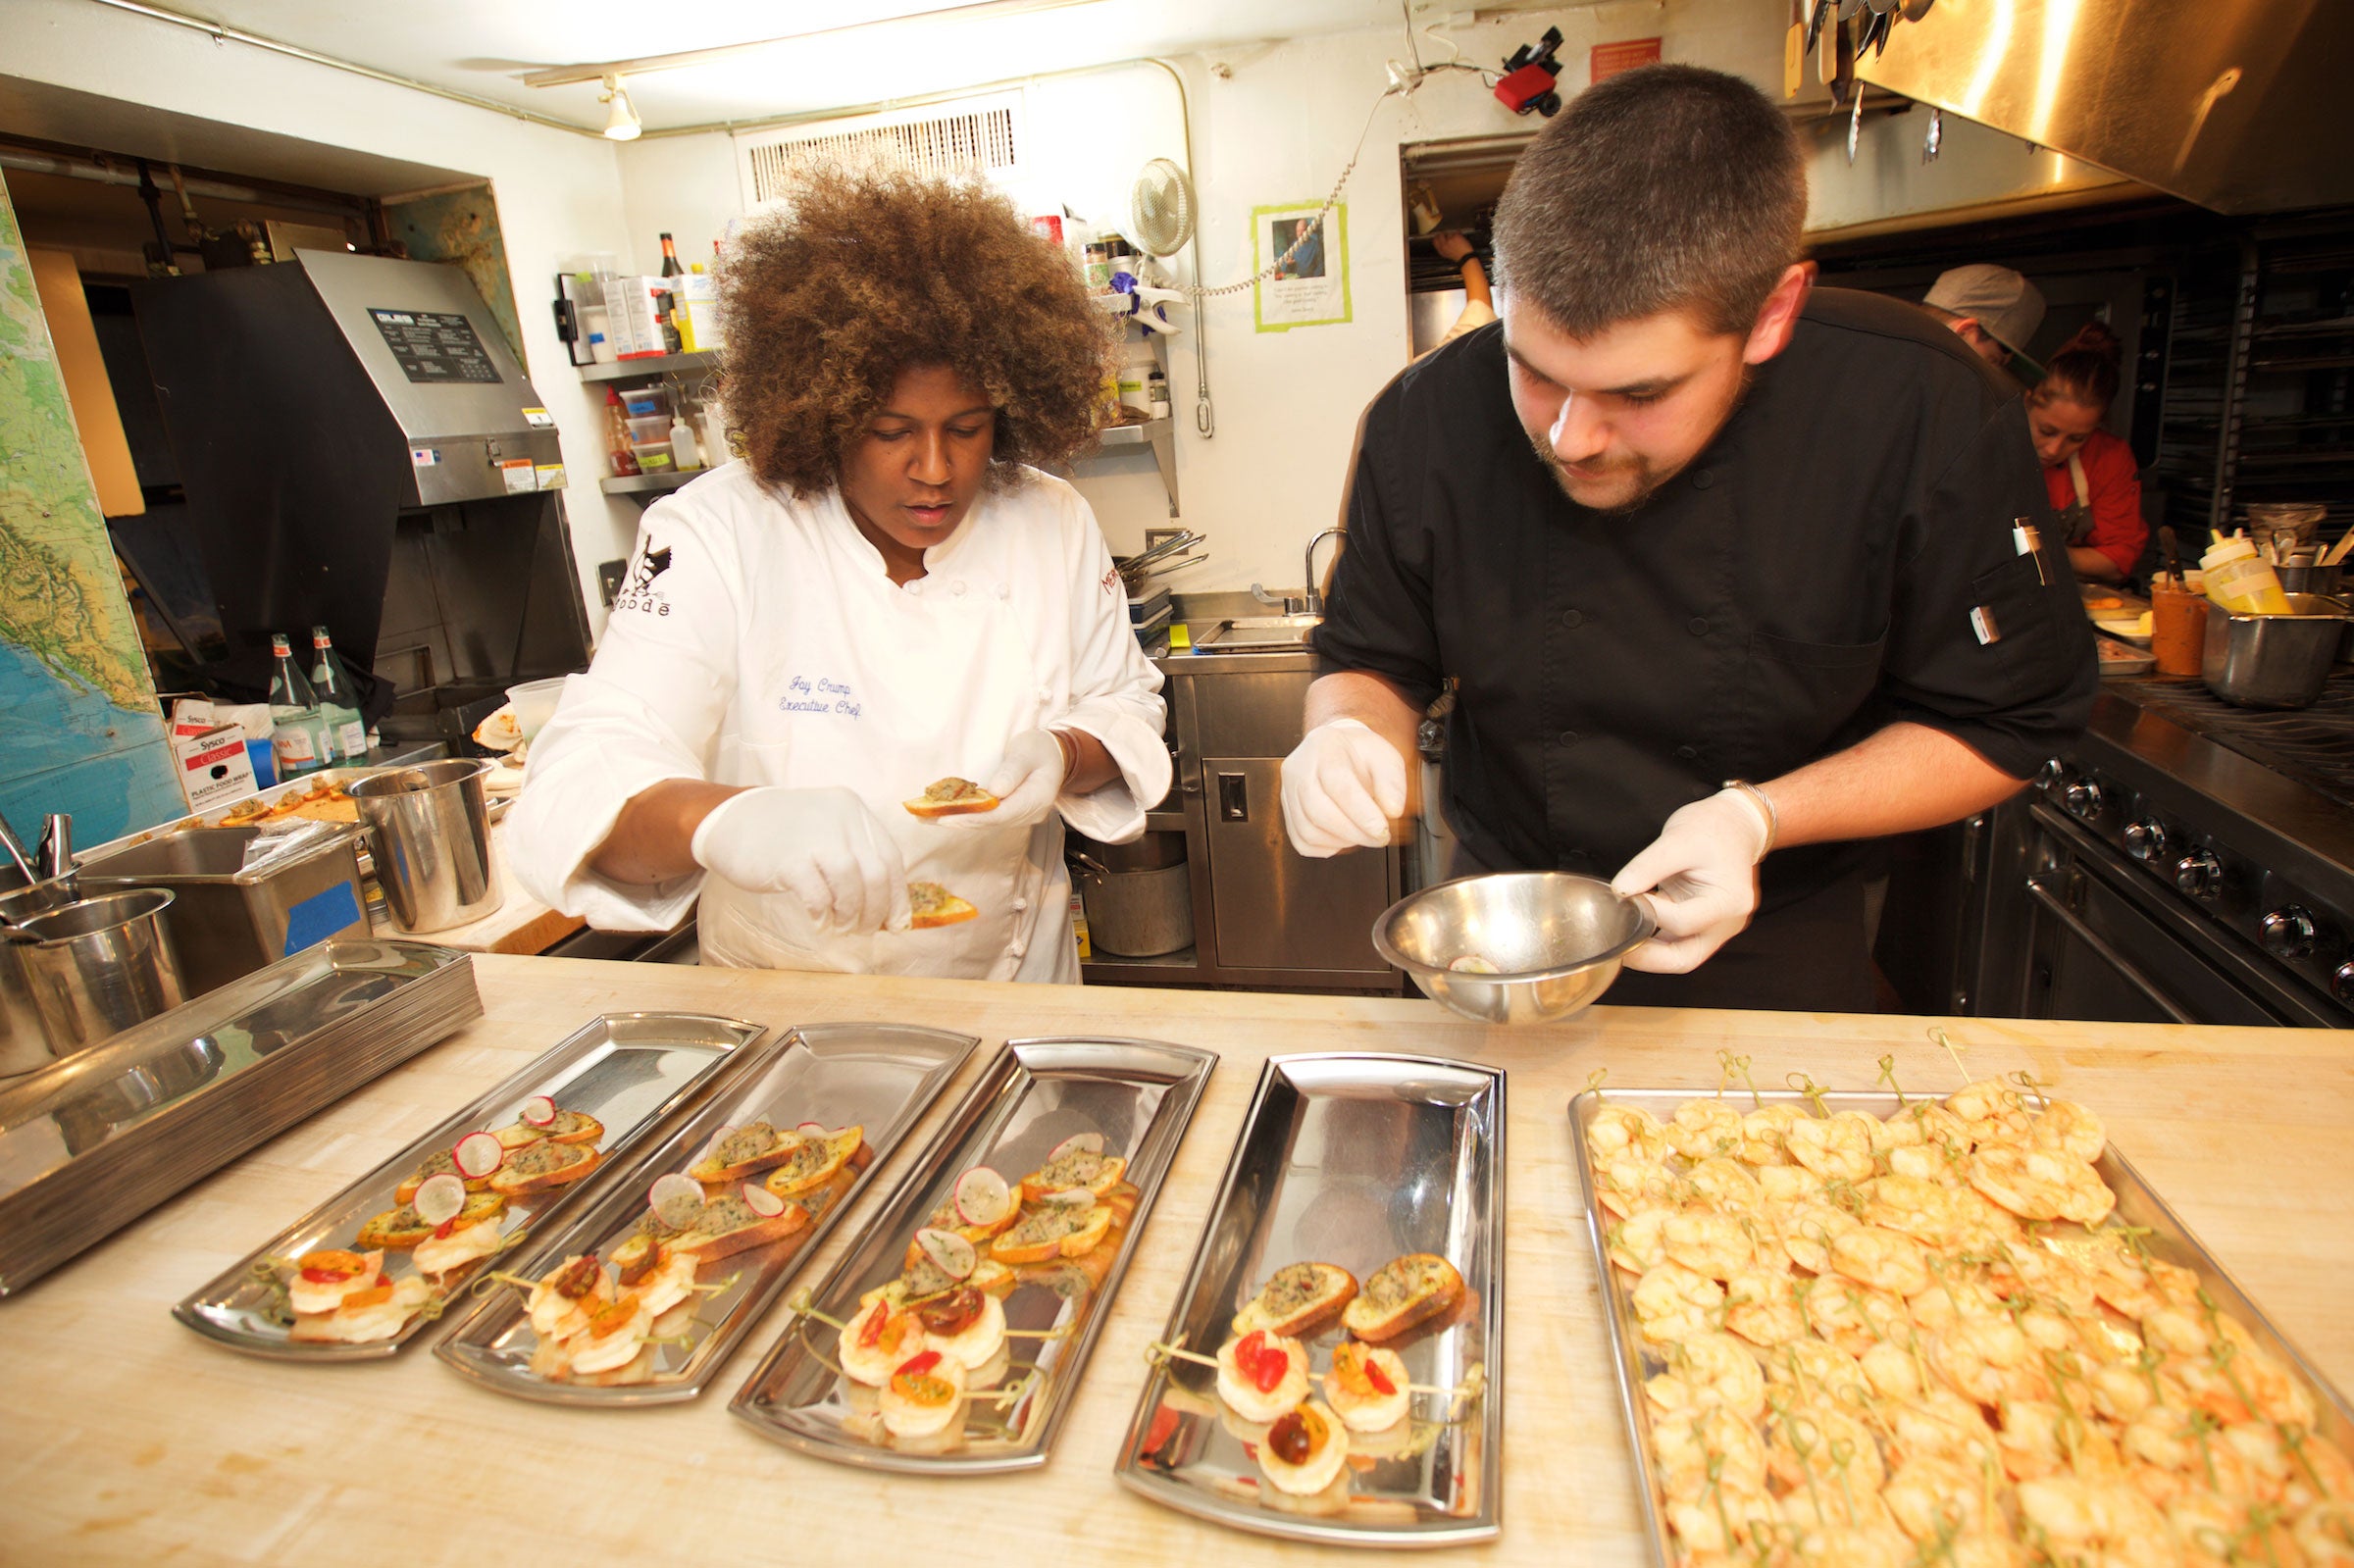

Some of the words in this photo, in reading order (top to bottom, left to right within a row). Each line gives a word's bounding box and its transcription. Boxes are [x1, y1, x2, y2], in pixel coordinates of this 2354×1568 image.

[817, 678, 850, 698] Crump
[779, 696, 830, 713] Executive
[836, 700, 861, 721] Chef
[187, 715, 205, 724] Sysco
[200, 737, 226, 751] Sysco
[200, 748, 232, 765] Classic
[191, 784, 215, 796] PLASTIC
[216, 778, 233, 788] FOOD
[232, 772, 249, 782] WRAP
